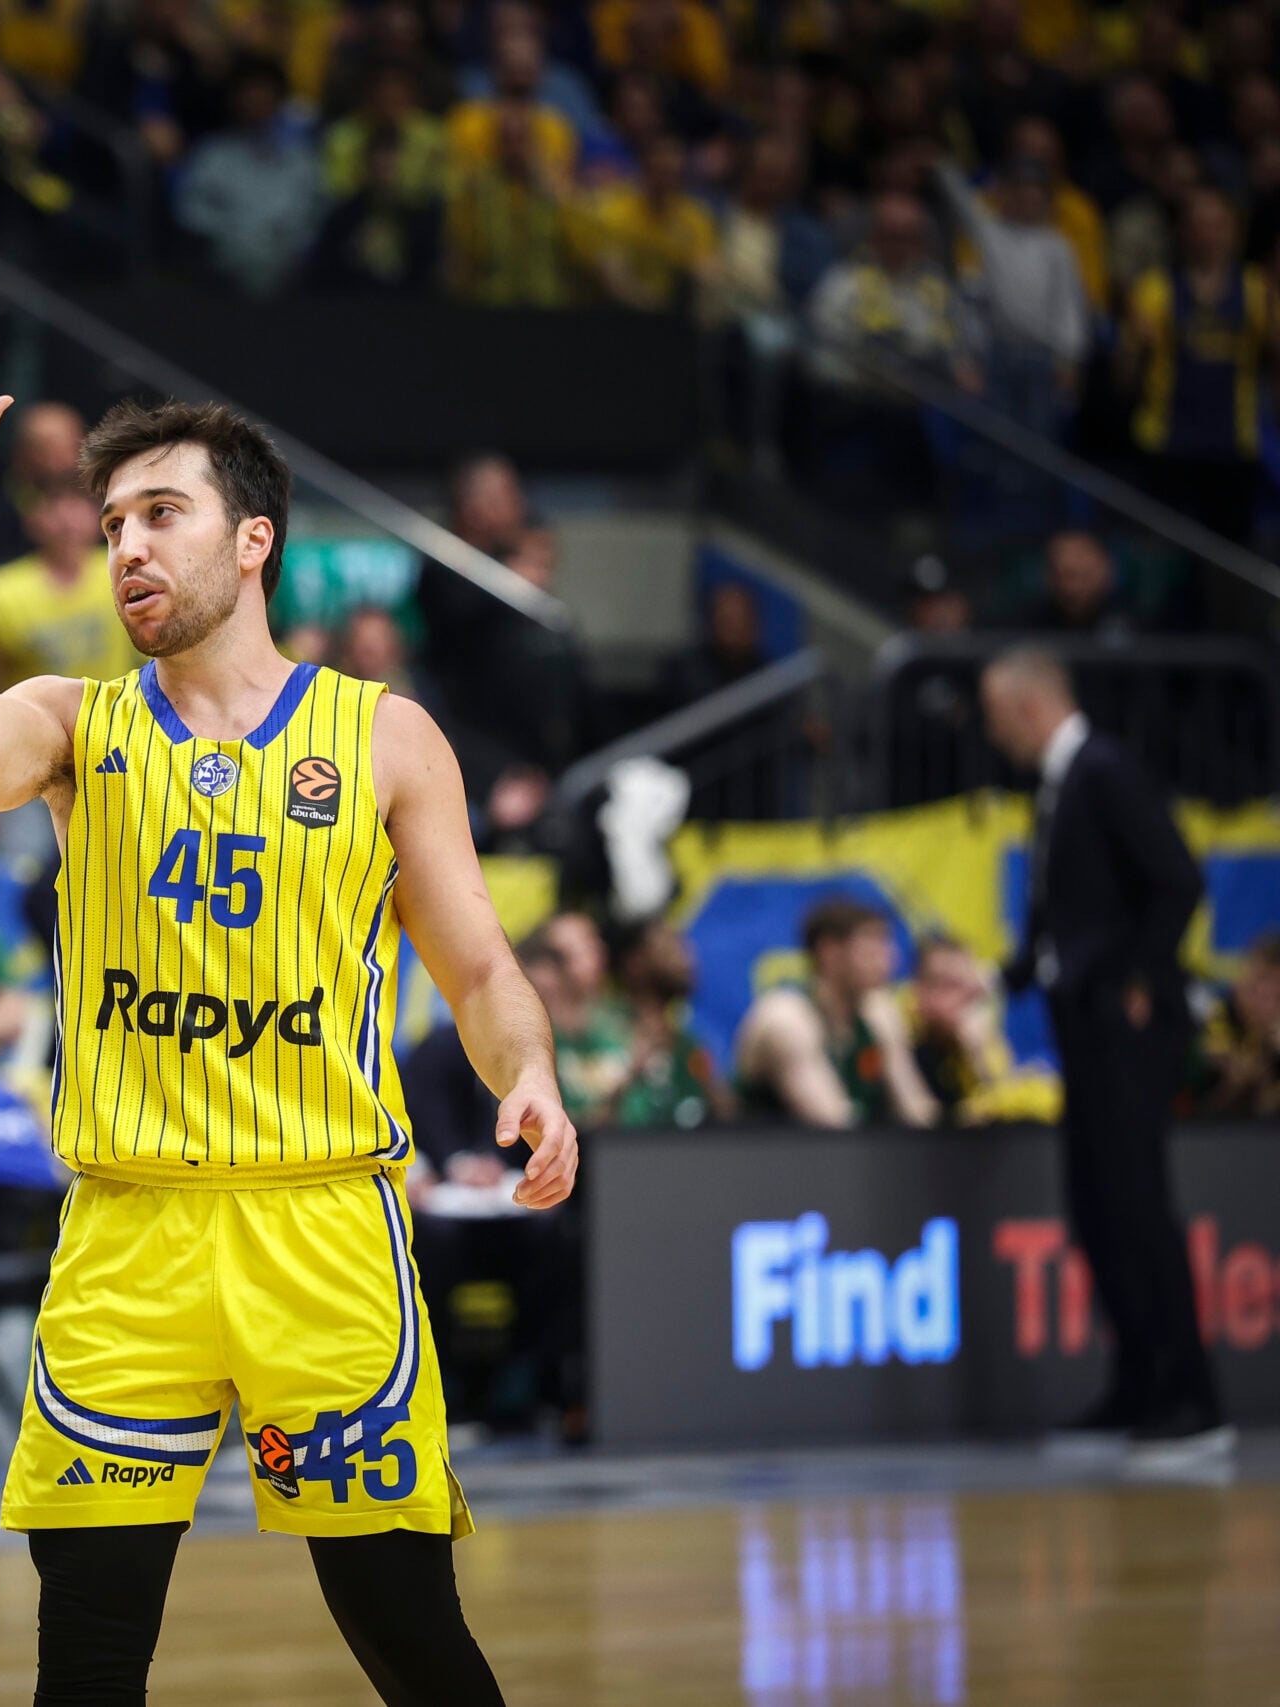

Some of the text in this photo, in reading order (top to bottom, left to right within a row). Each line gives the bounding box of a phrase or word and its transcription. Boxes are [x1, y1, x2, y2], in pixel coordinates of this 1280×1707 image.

[290, 808, 336, 823] abu dhabi
[147, 828, 267, 929] 45
[96, 967, 324, 1059] Rapyd
[730, 1209, 962, 1373] Find
[101, 1462, 176, 1489] Rapyd
[304, 1404, 418, 1504] 45
